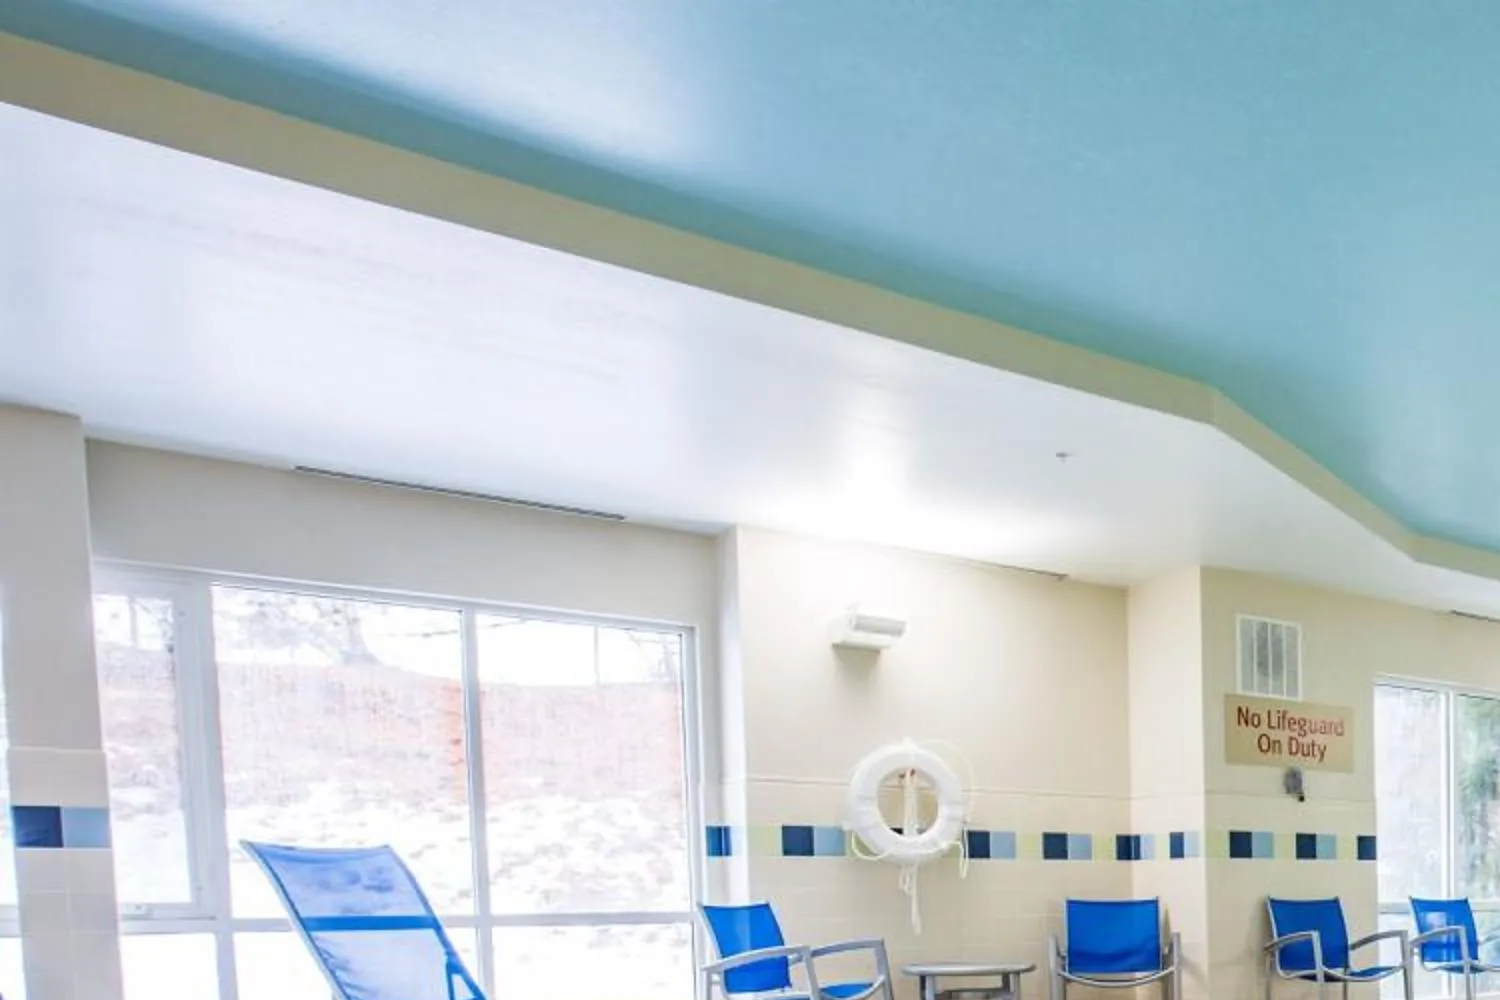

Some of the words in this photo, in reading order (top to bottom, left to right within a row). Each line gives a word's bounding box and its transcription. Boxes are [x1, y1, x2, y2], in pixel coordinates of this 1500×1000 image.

[1237, 706, 1261, 729] No
[1267, 709, 1344, 737] Lifeguard
[1257, 733, 1282, 756] On
[1288, 736, 1327, 762] Duty
